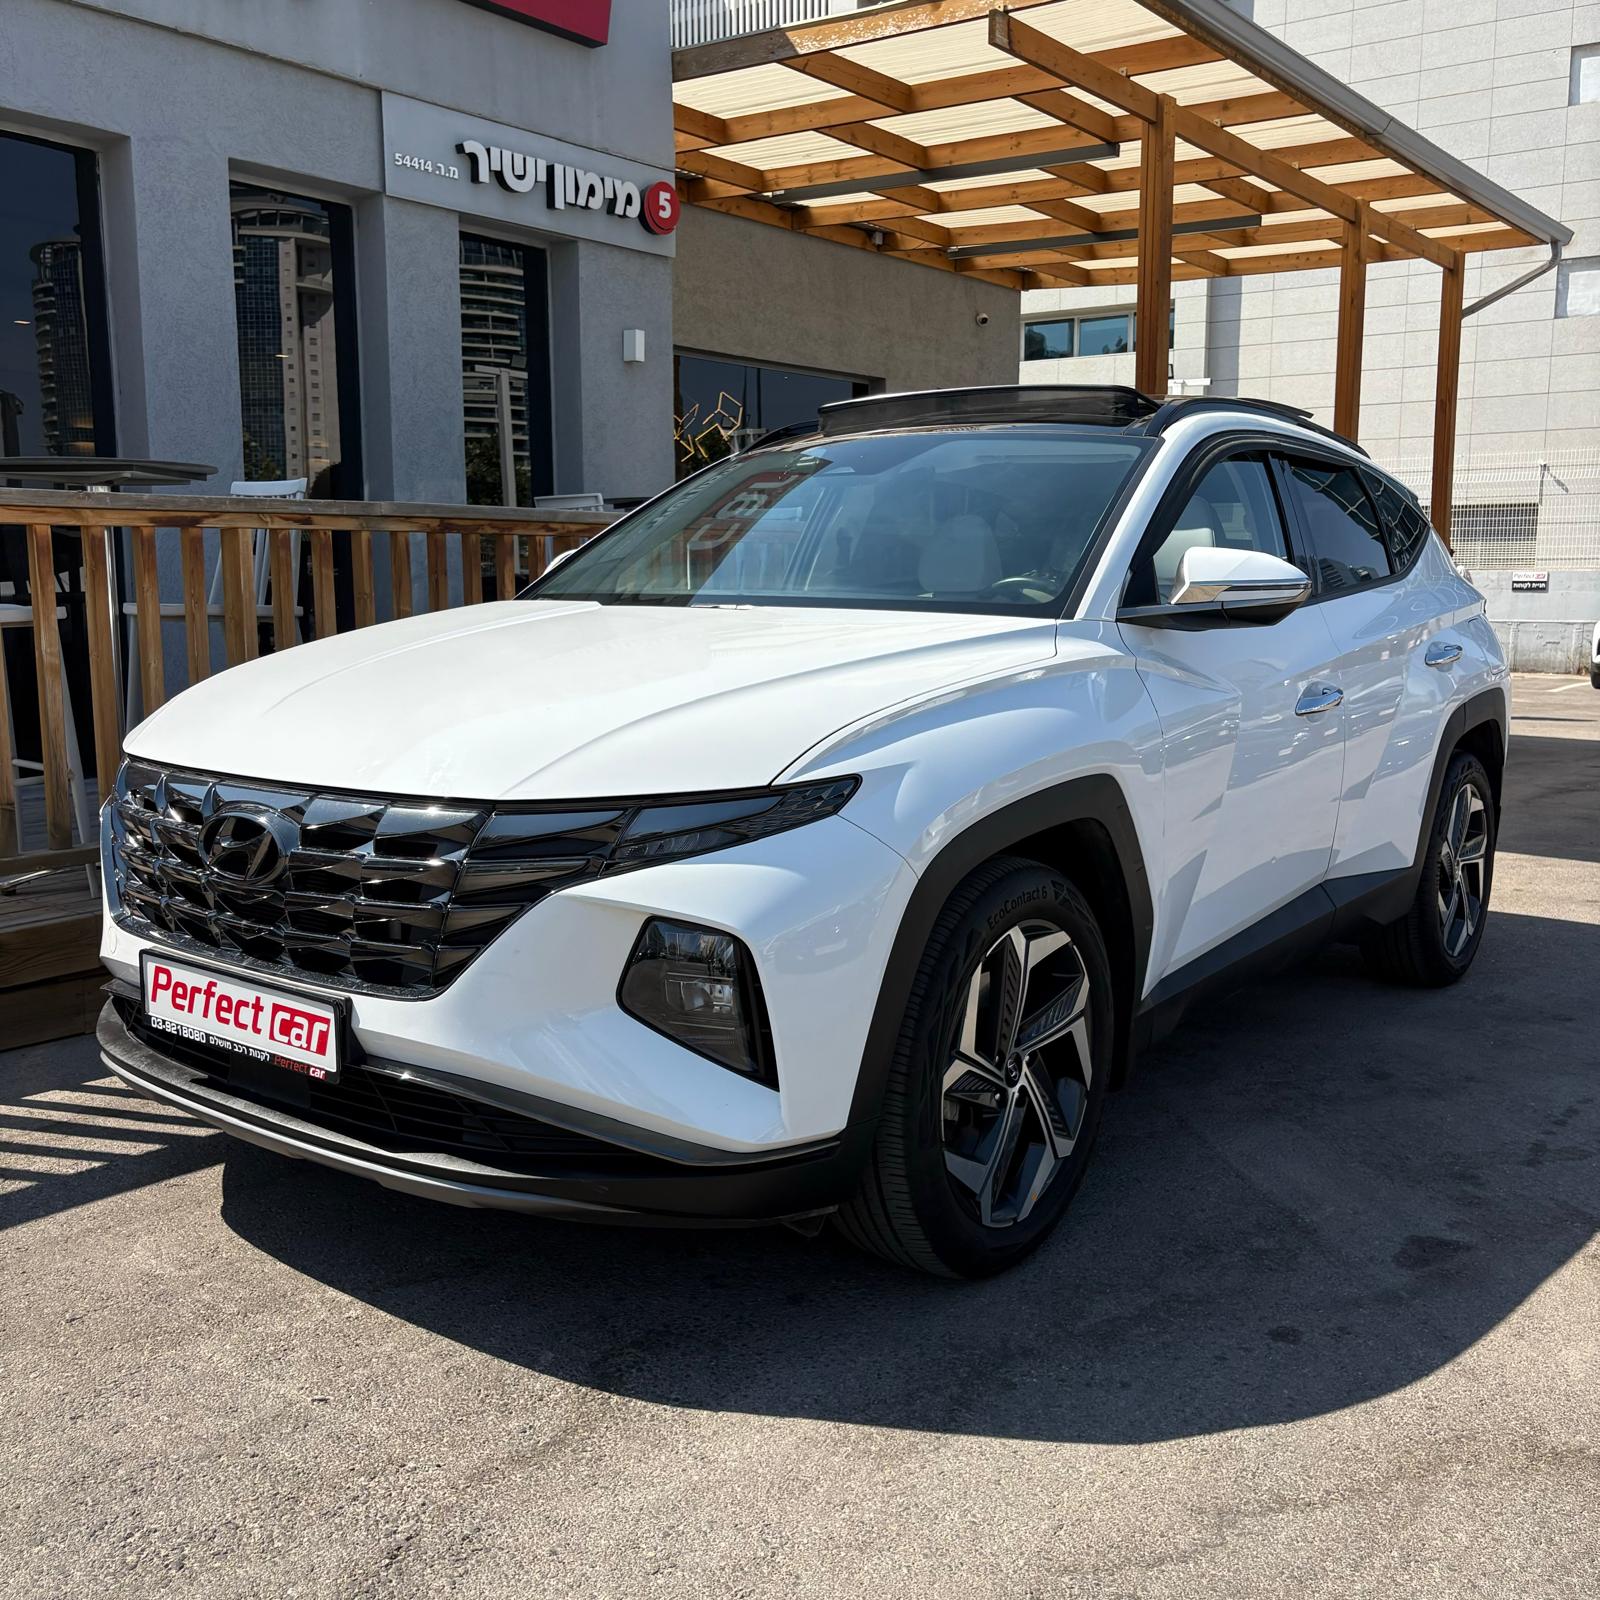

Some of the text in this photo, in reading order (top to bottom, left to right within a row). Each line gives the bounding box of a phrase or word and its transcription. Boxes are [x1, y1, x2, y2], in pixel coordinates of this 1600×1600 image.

[394, 152, 433, 173] 54414
[458, 139, 672, 219] 5 מימון ישיר
[986, 885, 1048, 929] EcoContact 6
[151, 965, 328, 1053] Perfect car
[151, 1016, 206, 1043] 03-9218080
[209, 1036, 270, 1061] לקנות רכב מושלם
[274, 1055, 326, 1079] Perfect car
